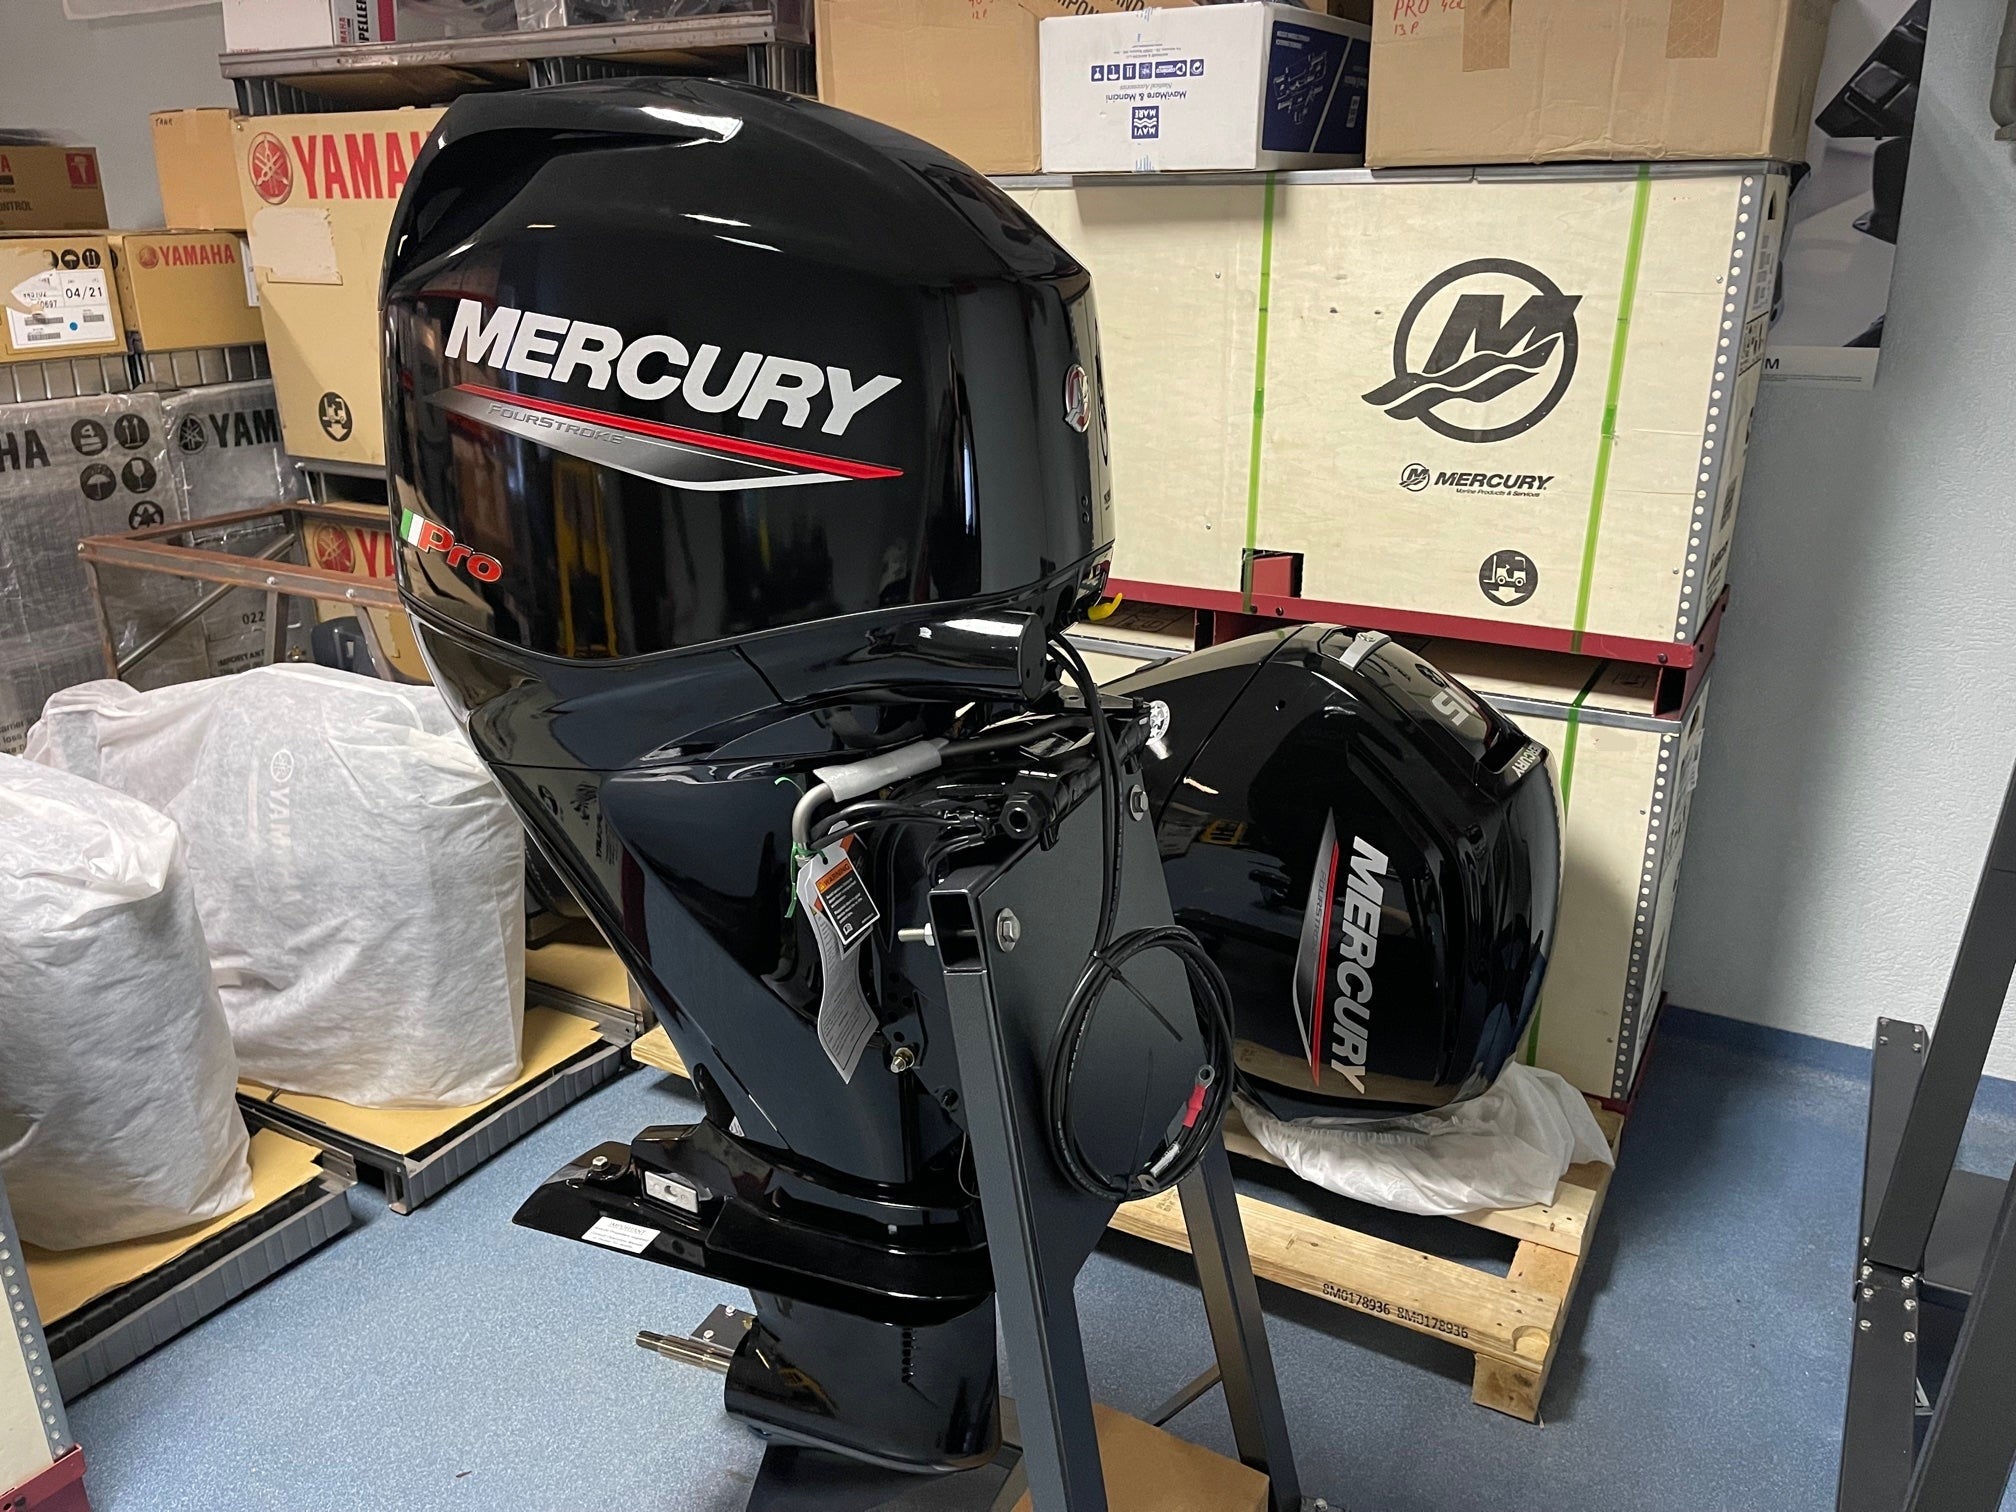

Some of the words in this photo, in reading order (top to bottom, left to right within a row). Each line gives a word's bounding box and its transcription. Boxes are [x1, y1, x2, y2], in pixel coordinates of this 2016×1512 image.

[1106, 93, 1136, 103] Mancini
[1139, 93, 1144, 101] &
[1147, 91, 1187, 100] MaviMare
[1135, 109, 1157, 118] MARE
[1134, 127, 1156, 136] MAVI
[159, 244, 235, 266] YAMAHA
[65, 287, 102, 299] 04/21
[445, 298, 902, 436] MERCURY
[488, 402, 622, 444] FOURSTROKE
[1434, 472, 1555, 490] MERCURY
[417, 519, 503, 583] Pro
[1511, 742, 1542, 778] ERCURY
[823, 863, 851, 887] WARNING
[1331, 836, 1389, 1095] MERCURY
